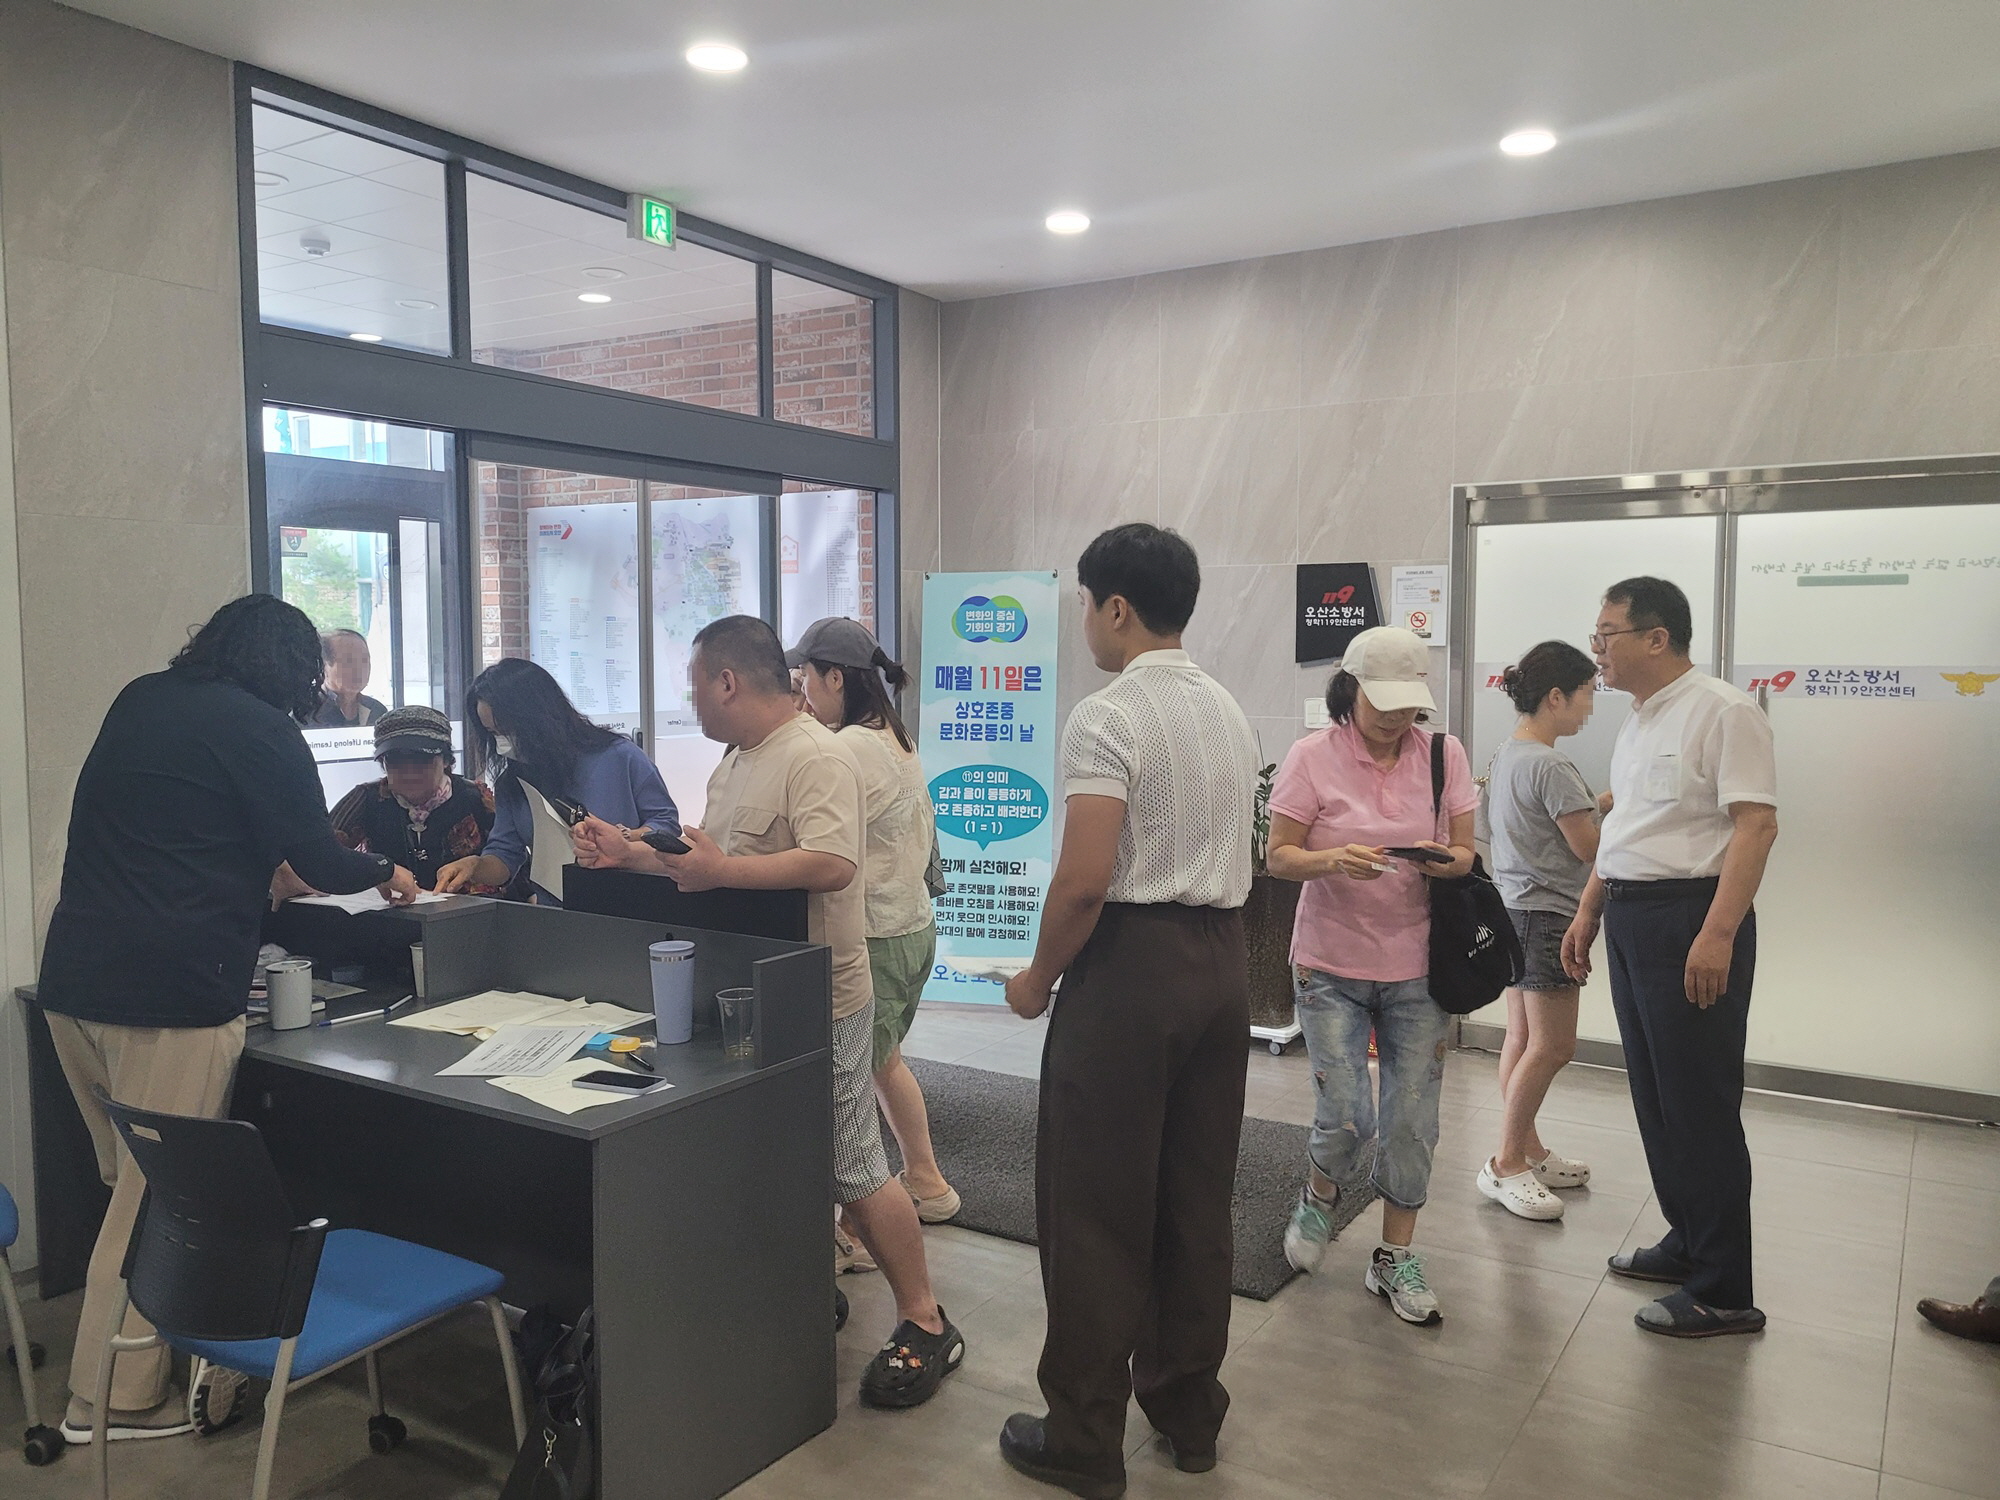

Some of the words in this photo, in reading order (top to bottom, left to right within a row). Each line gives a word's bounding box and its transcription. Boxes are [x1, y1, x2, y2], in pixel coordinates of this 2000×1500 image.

[1322, 585, 1355, 604] 119
[965, 610, 994, 621] 변화의
[996, 610, 1016, 621] 중심
[1305, 606, 1365, 618] 오산소방서
[965, 622, 994, 633] 기회의
[996, 622, 1016, 633] 경기
[1305, 618, 1365, 627] 청학119안전센터
[935, 665, 973, 691] 매월
[980, 665, 1042, 691] 11일은
[1804, 668, 1900, 684] 오산소방서
[1804, 685, 1916, 697] 청학119안전센터
[956, 701, 1014, 720] 상호존중
[940, 723, 1013, 742] 문화운동의
[1020, 724, 1035, 742] 날
[986, 771, 1009, 784] 의미
[938, 786, 961, 799] 갑과
[963, 787, 985, 800] 을이
[987, 788, 1032, 802] 동등하게
[952, 804, 995, 817] 존중하고
[997, 805, 1042, 819] 배려한다
[940, 858, 965, 873] 함께
[970, 860, 1027, 876] 실천해요!
[946, 883, 955, 893] 로
[958, 883, 995, 895] 존댓말을
[998, 885, 1040, 897] 사용해요!
[936, 897, 964, 908] 올바른
[966, 898, 995, 910] 호칭을
[997, 900, 1039, 912] 사용해요!
[936, 911, 955, 922] 먼저
[957, 912, 985, 923] 웃으며
[988, 913, 1030, 926] 인사해요!
[935, 926, 963, 937] 상대의
[966, 927, 985, 938] 말에
[988, 928, 1030, 941] 경청해요!
